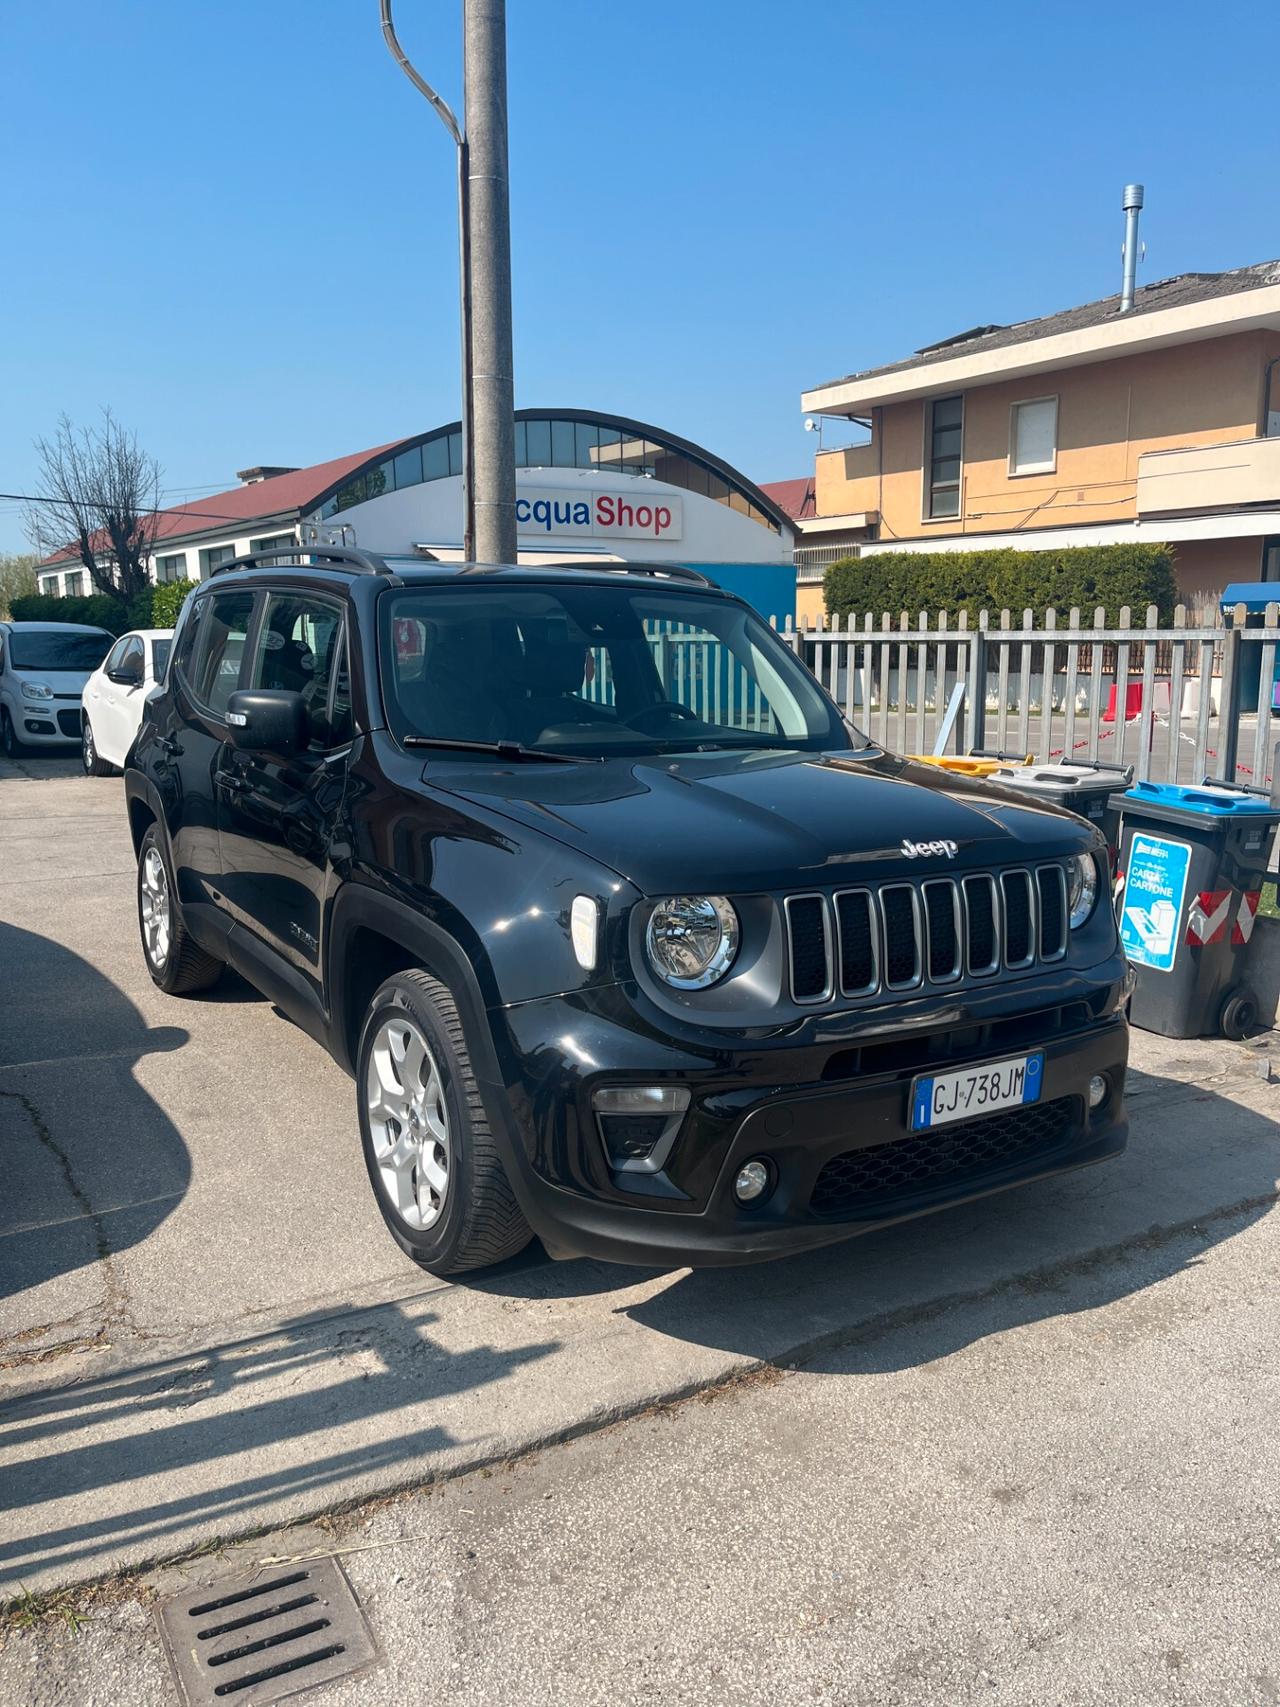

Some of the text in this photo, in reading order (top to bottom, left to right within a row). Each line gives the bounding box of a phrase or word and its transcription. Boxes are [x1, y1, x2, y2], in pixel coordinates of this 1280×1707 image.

[515, 496, 671, 536] cqua Shop
[900, 839, 959, 859] Jeep
[1129, 877, 1174, 898] CARTONE
